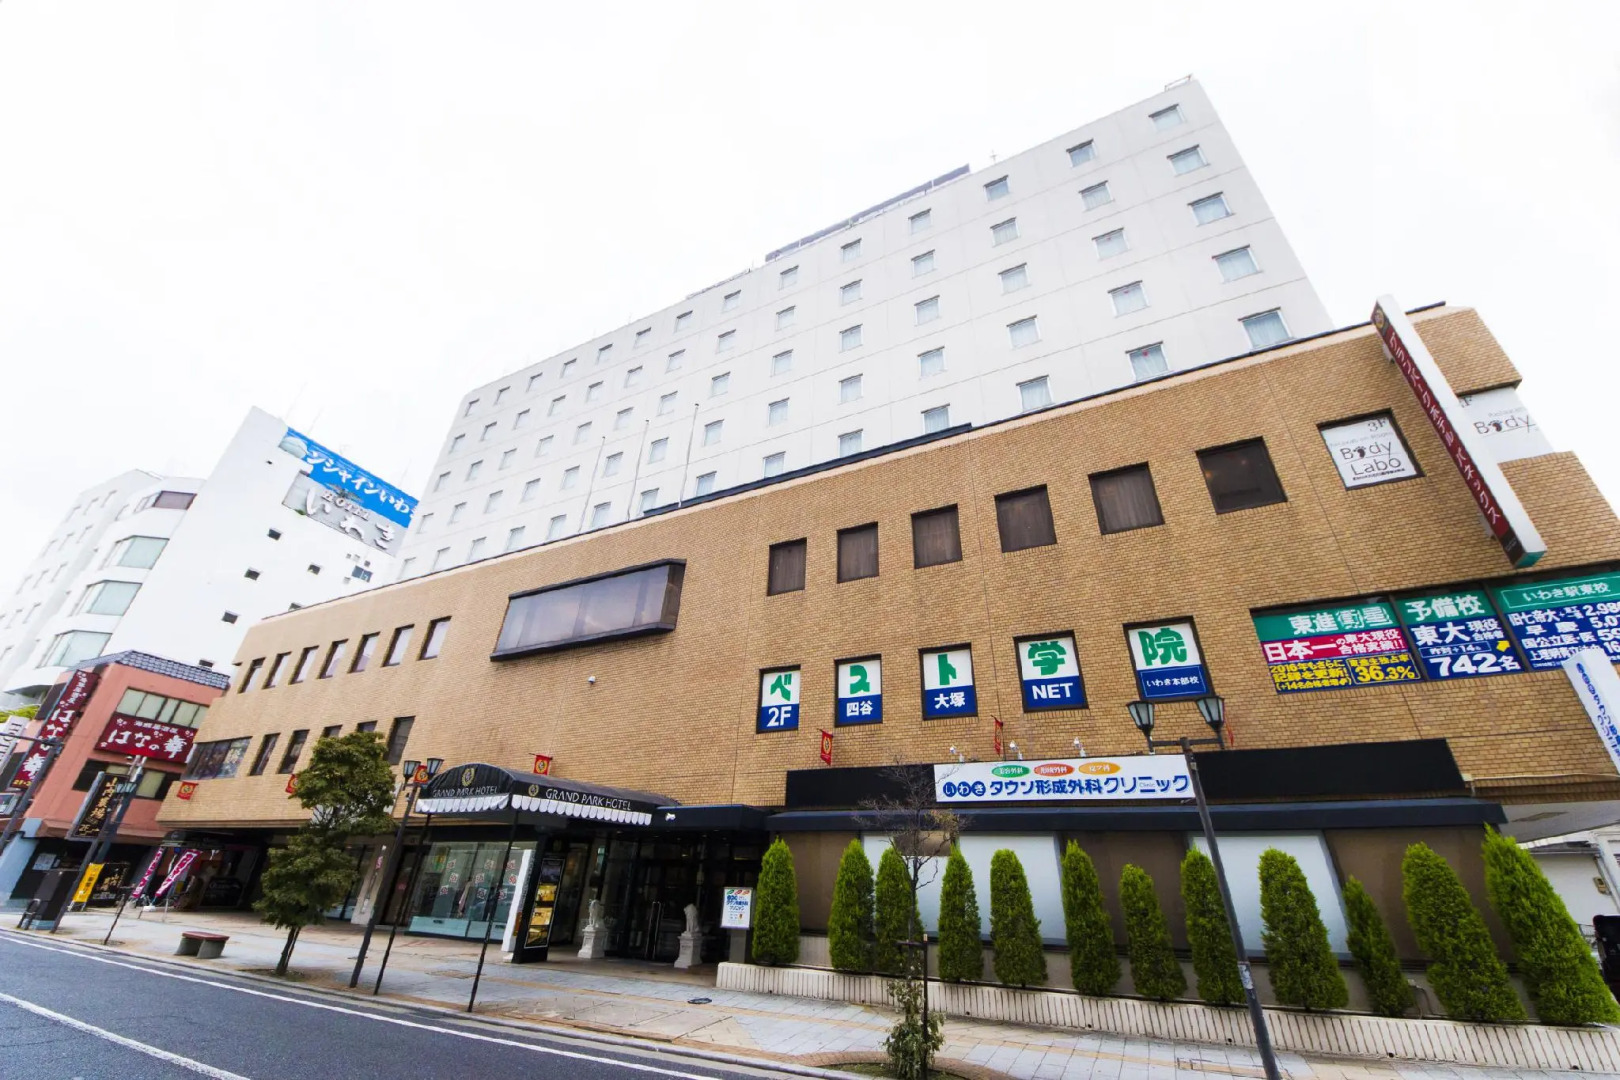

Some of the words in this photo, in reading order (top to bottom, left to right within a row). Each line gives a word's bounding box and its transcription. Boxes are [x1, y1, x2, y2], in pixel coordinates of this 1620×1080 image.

[1340, 441, 1391, 460] Body
[1351, 458, 1401, 476] Labo
[321, 489, 370, 521] HOTEL
[306, 487, 395, 550] いわき
[1522, 582, 1611, 602] いわき駅東校
[1405, 594, 1485, 621] 予備校
[1583, 601, 1620, 617] 2,98
[1410, 622, 1471, 646] 東大
[1466, 618, 1502, 632] 現役
[1589, 614, 1620, 629] 5,0
[849, 664, 870, 695] ス
[938, 653, 957, 686] ト
[1028, 639, 1066, 676] 学
[1138, 627, 1187, 667] 院
[1264, 640, 1337, 663] 日本一
[1355, 665, 1415, 683] 36.3%
[1429, 652, 1521, 677] 742名
[766, 706, 792, 728] 2F
[846, 700, 873, 717] 四谷
[934, 691, 965, 710] 大塚
[1031, 681, 1076, 701] NET
[1146, 675, 1200, 687] いわき本部校
[433, 789, 455, 798] GRAND
[456, 787, 474, 796] PARK
[476, 785, 497, 795] HOTEL
[545, 788, 580, 803] GRAND
[580, 794, 604, 807] PARK
[605, 798, 632, 811] HOTEL
